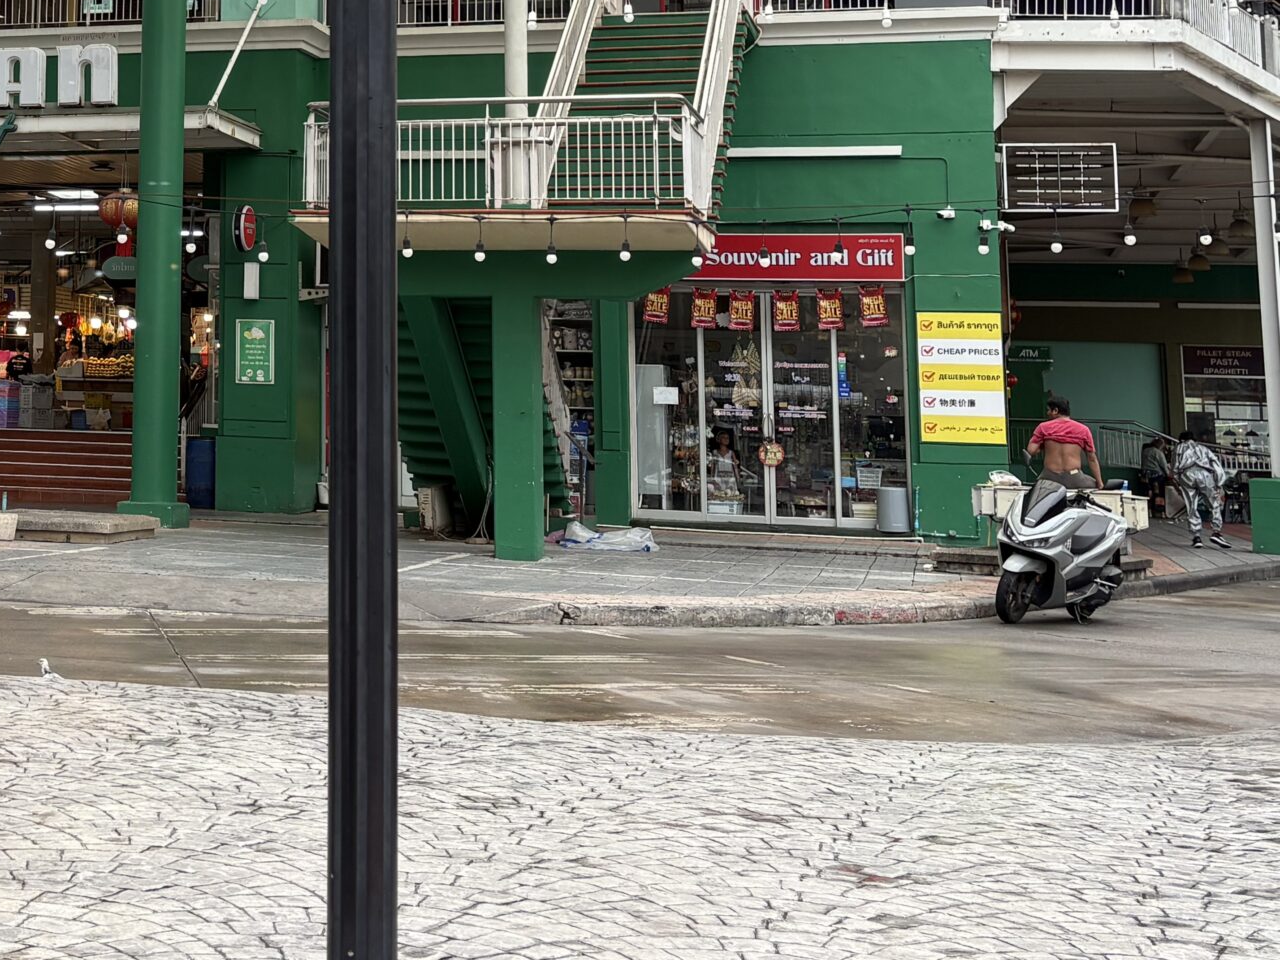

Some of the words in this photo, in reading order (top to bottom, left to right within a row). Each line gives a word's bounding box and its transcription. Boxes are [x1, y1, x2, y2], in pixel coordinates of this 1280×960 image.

[706, 248, 801, 266] Souvnir
[856, 248, 894, 266] Gift
[648, 293, 667, 303] MEGA
[695, 298, 715, 308] MEGA
[863, 295, 883, 305] MEGA
[646, 302, 668, 313] SALE
[732, 300, 752, 310] MEGA
[776, 301, 796, 310] MEGA
[820, 299, 840, 309] MEGA
[863, 303, 886, 315] SALE
[693, 306, 715, 317] SALE
[731, 308, 753, 320] SALE
[776, 308, 798, 320] SALE
[820, 307, 841, 318] SALE
[968, 348, 1000, 356] PRICES
[1019, 349, 1038, 358] ATM
[1211, 358, 1239, 366] PASTA
[939, 373, 976, 381] ДЕШЕВЫЙ
[939, 398, 976, 408] 物美价廉
